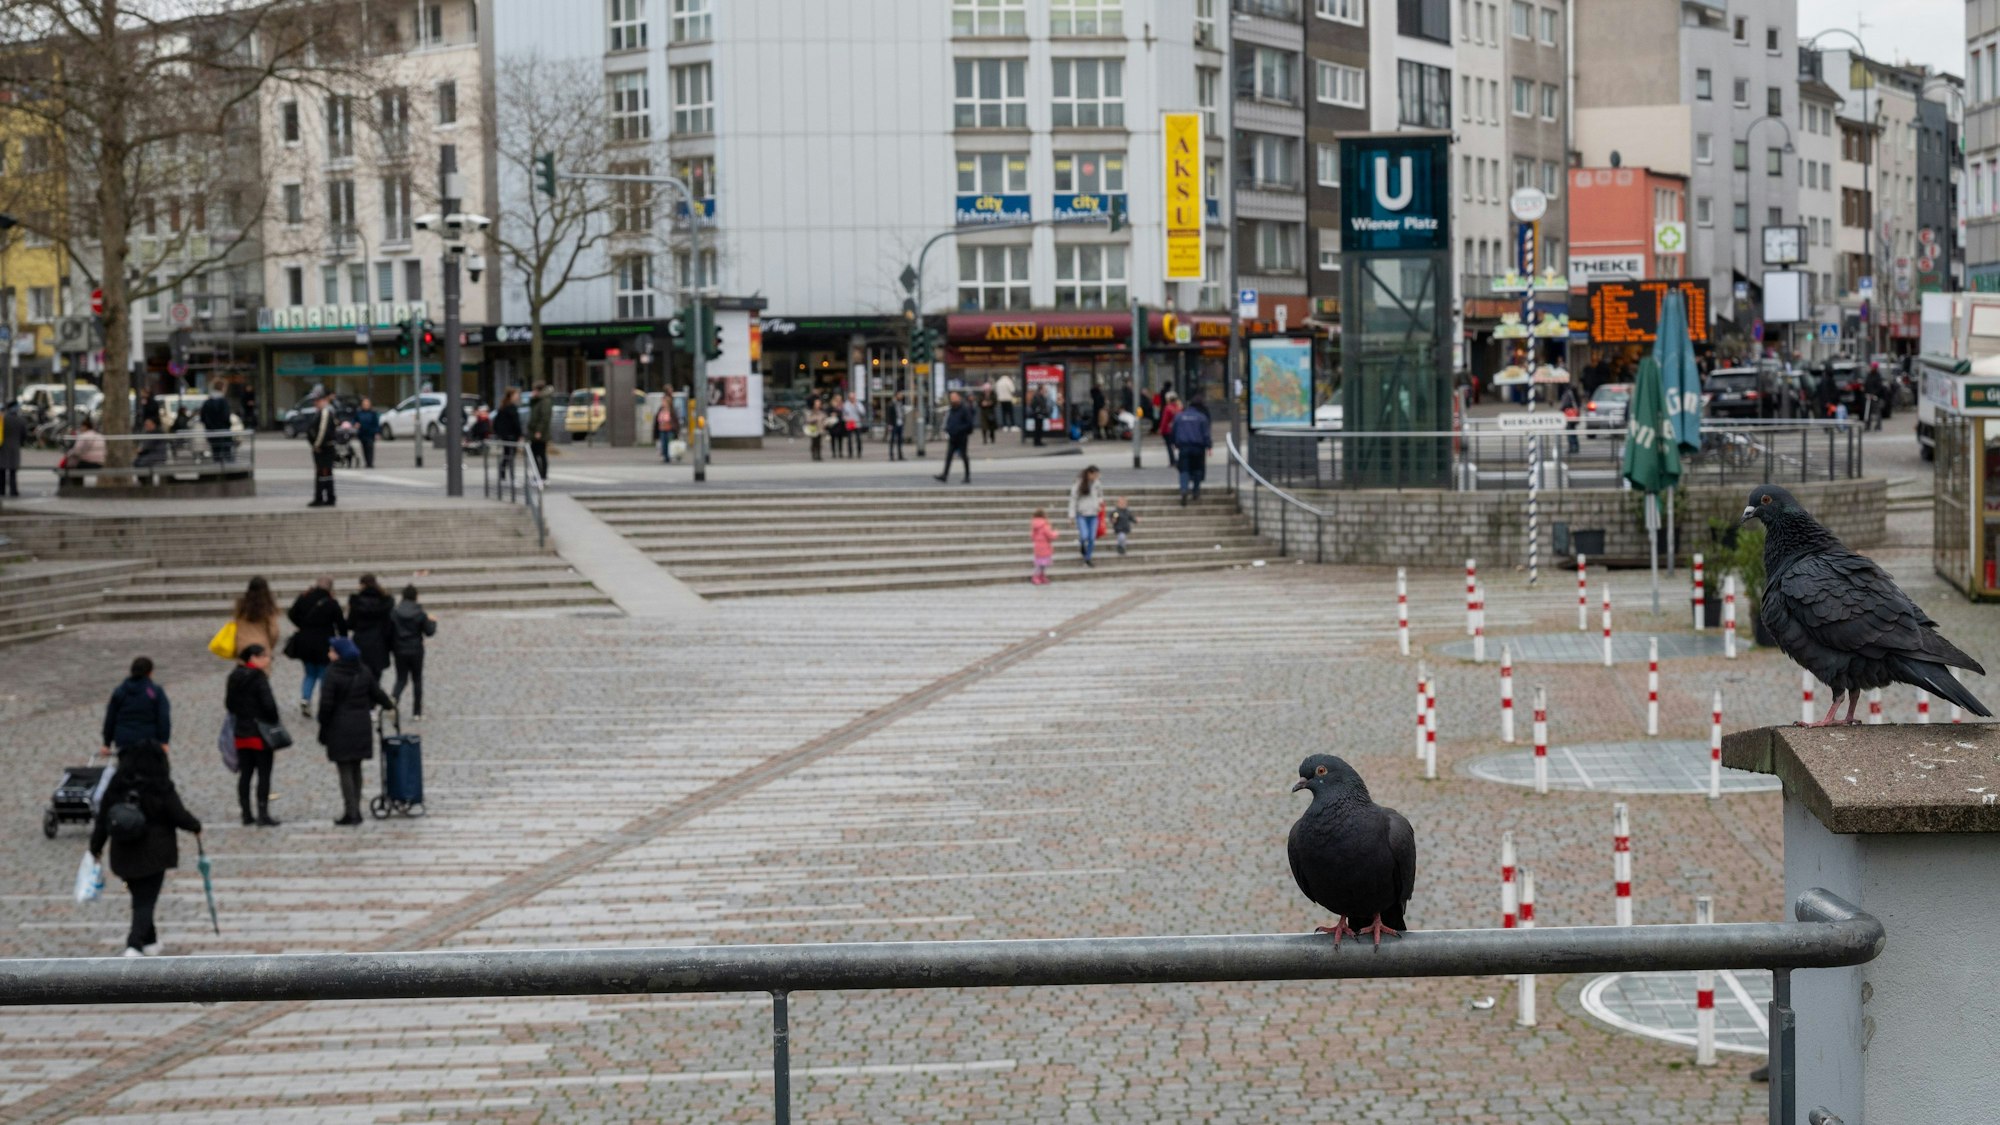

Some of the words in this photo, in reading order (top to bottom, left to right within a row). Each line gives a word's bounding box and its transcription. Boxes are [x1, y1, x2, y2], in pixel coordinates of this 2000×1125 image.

[1174, 136, 1191, 225] AKSU
[1375, 156, 1413, 211] U
[975, 195, 1003, 213] city
[1072, 195, 1100, 211] city
[1351, 217, 1400, 231] Wiener
[1404, 216, 1438, 230] Platz
[1573, 260, 1638, 273] THEKE
[986, 322, 1037, 340] AKSU
